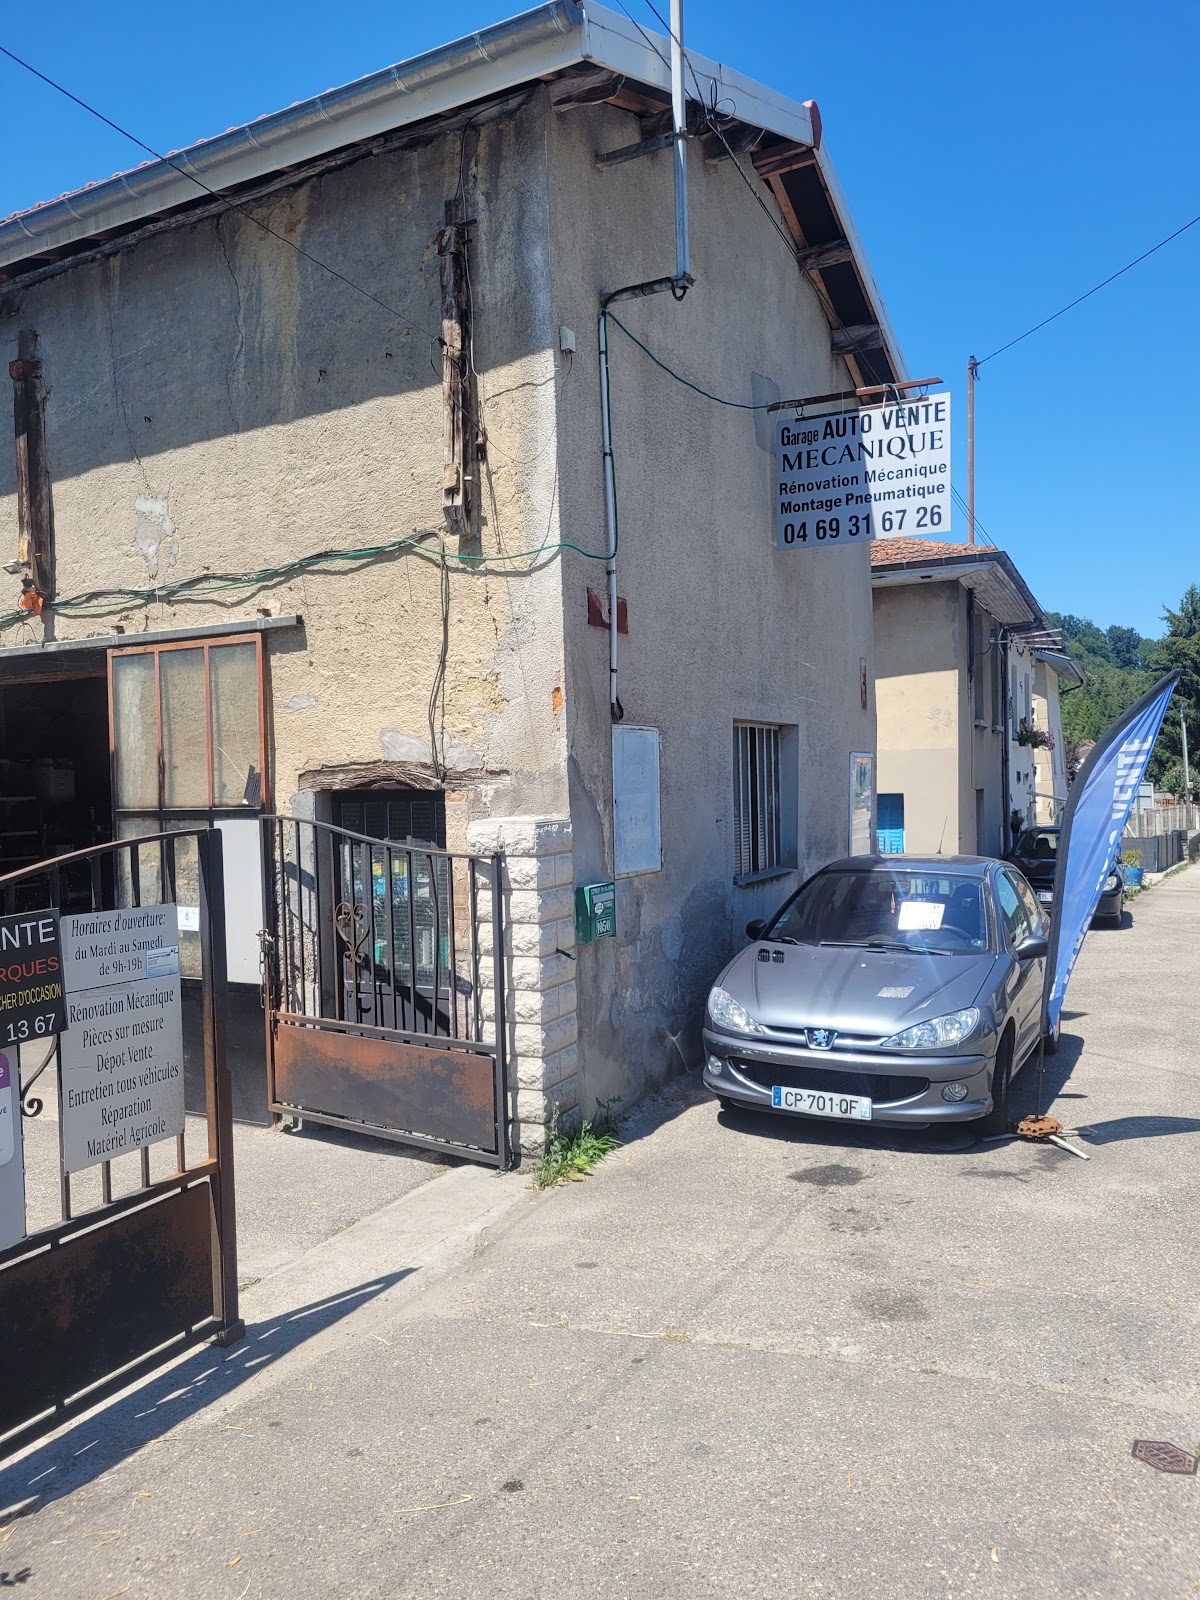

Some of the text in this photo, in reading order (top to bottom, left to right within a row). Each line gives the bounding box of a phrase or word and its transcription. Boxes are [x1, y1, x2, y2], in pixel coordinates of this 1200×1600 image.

[781, 401, 946, 446] Garage AUTO VENTE
[782, 430, 943, 472] MECANIQUE
[779, 463, 947, 495] Rénovation Mécanique
[780, 483, 945, 515] Montage Pneumatique
[784, 504, 942, 544] 04 69 31 67 26
[0, 918, 56, 951] NTE
[71, 913, 166, 937] Horaires d'ouverture:
[75, 935, 163, 960] du Mardi au Samedi
[99, 963, 110, 976] de
[112, 957, 143, 974] 9h-19h
[18, 982, 62, 1007] D'OCCASION
[69, 987, 174, 1023] Rénovation Mécanique
[7, 1012, 56, 1042] 13 67
[82, 1016, 164, 1048] Pièces sur mesure
[68, 1062, 179, 1108] Entretien tous véhicules
[101, 1097, 152, 1127] Réparation
[784, 1091, 859, 1115] CP-701-QF
[87, 1116, 166, 1158] Matériel Agricole
